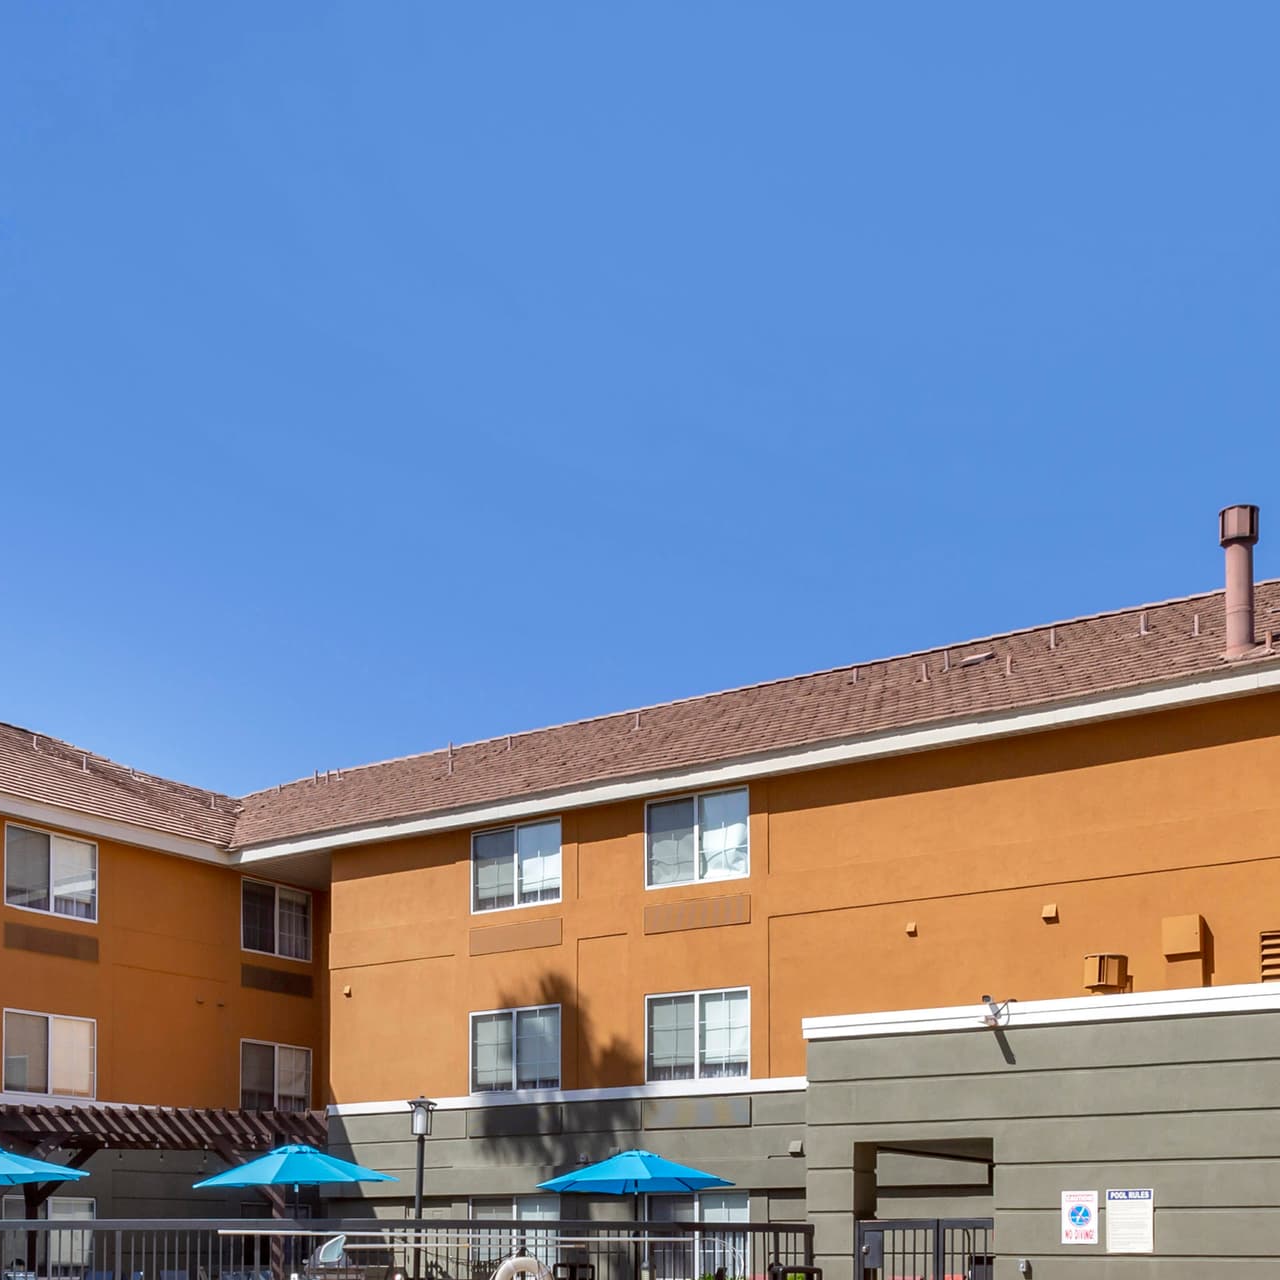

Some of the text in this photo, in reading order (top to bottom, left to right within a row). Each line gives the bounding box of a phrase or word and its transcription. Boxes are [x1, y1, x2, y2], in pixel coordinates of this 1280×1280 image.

[1110, 1191, 1149, 1200] POOL RULES
[1065, 1229, 1095, 1240] NO DIVING!
